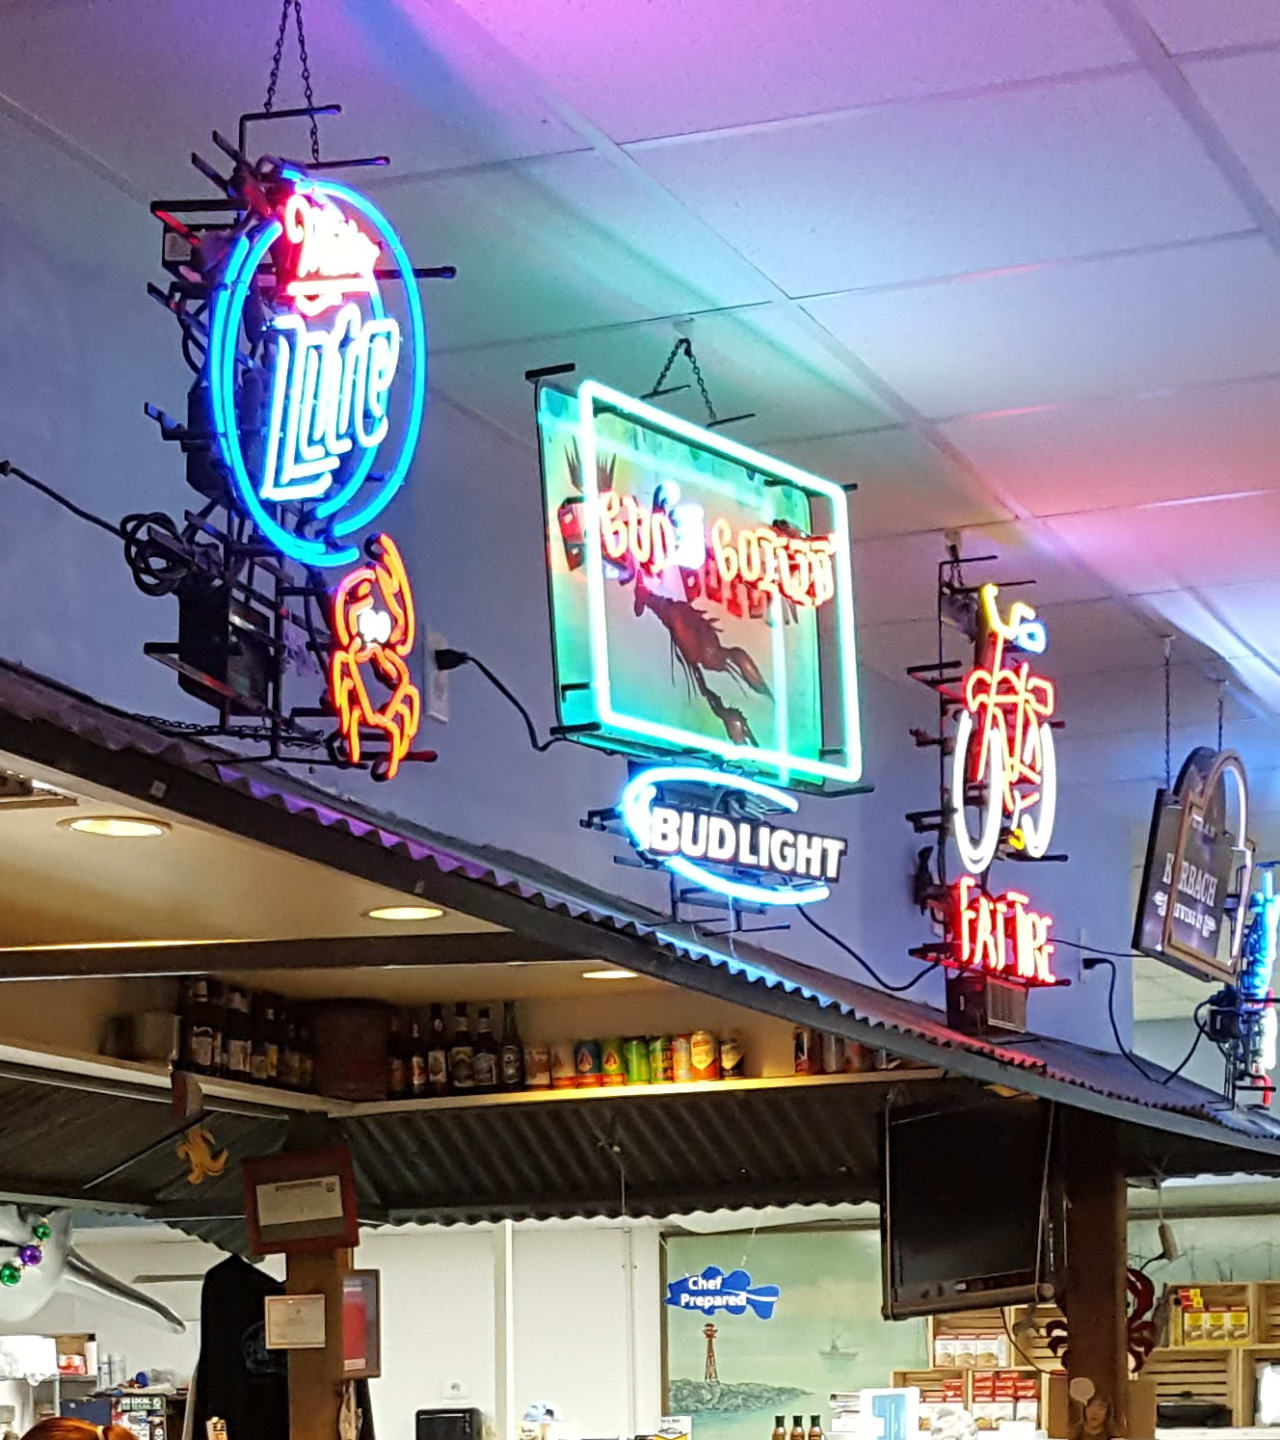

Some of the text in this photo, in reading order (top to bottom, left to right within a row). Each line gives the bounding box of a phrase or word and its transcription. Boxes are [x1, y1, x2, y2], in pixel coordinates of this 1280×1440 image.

[1163, 851, 1218, 907] KRBACH
[688, 1275, 723, 1291] Chef
[680, 1292, 748, 1310] Prepared
